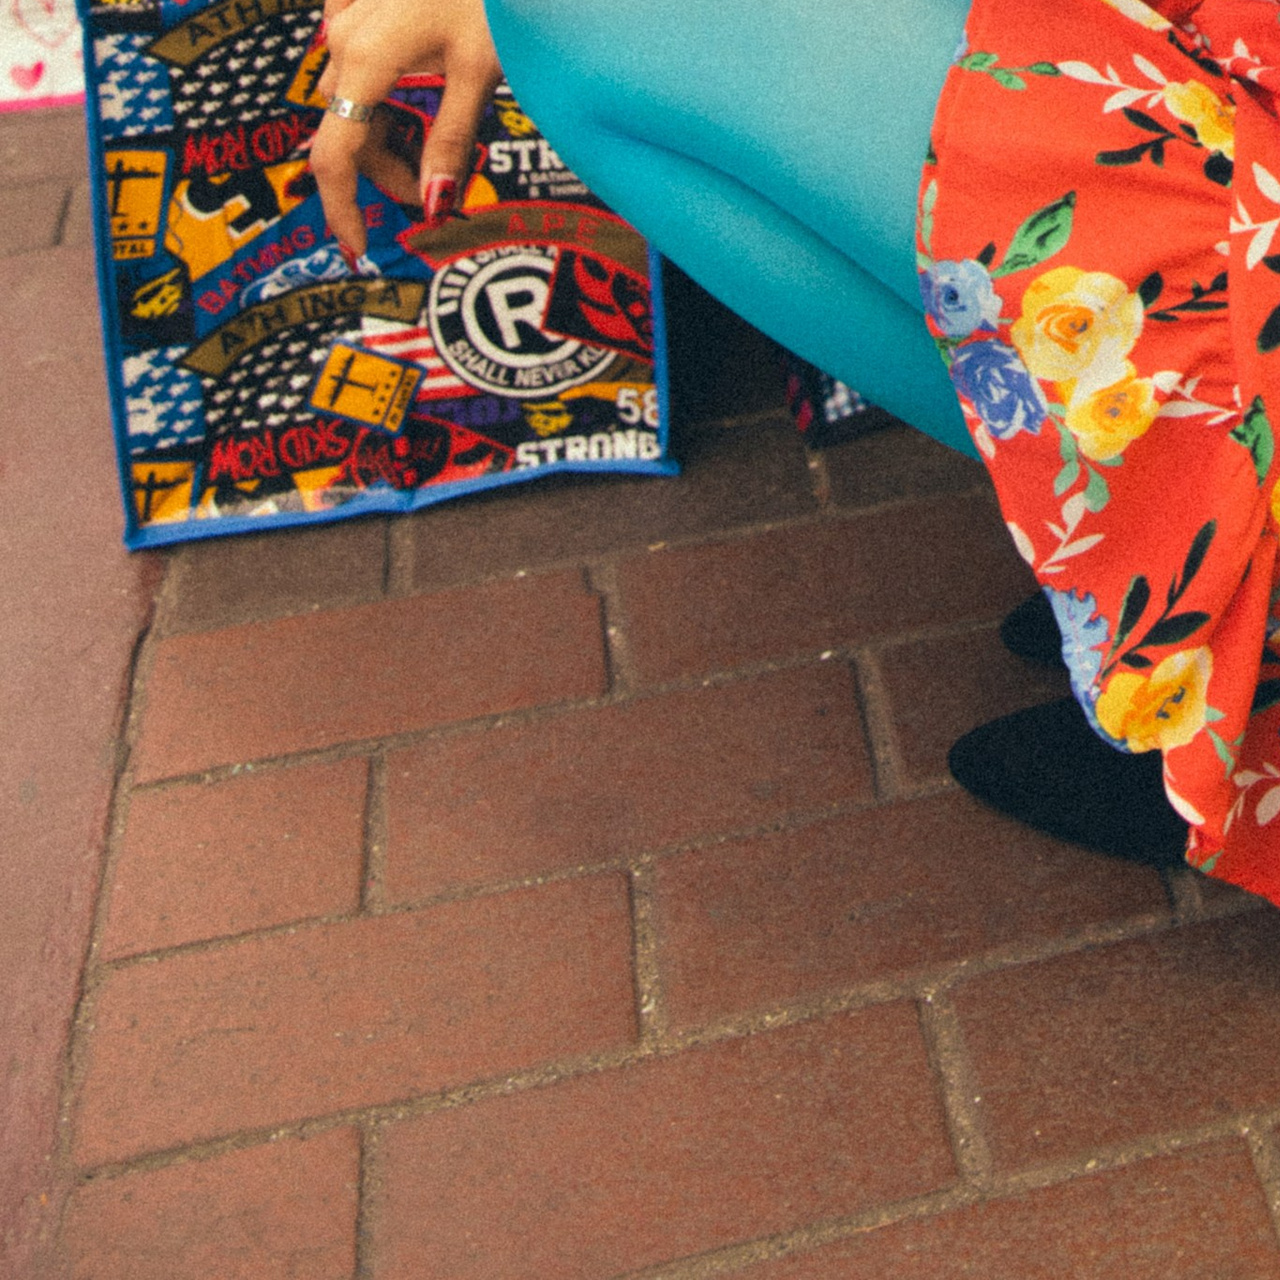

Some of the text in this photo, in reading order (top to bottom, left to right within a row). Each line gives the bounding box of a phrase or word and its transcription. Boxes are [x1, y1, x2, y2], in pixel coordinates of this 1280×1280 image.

[197, 226, 315, 315] BATHING
[485, 275, 565, 350] R
[450, 339, 510, 387] SHALL
[514, 359, 582, 387] NEVER
[278, 419, 351, 468] SKID
